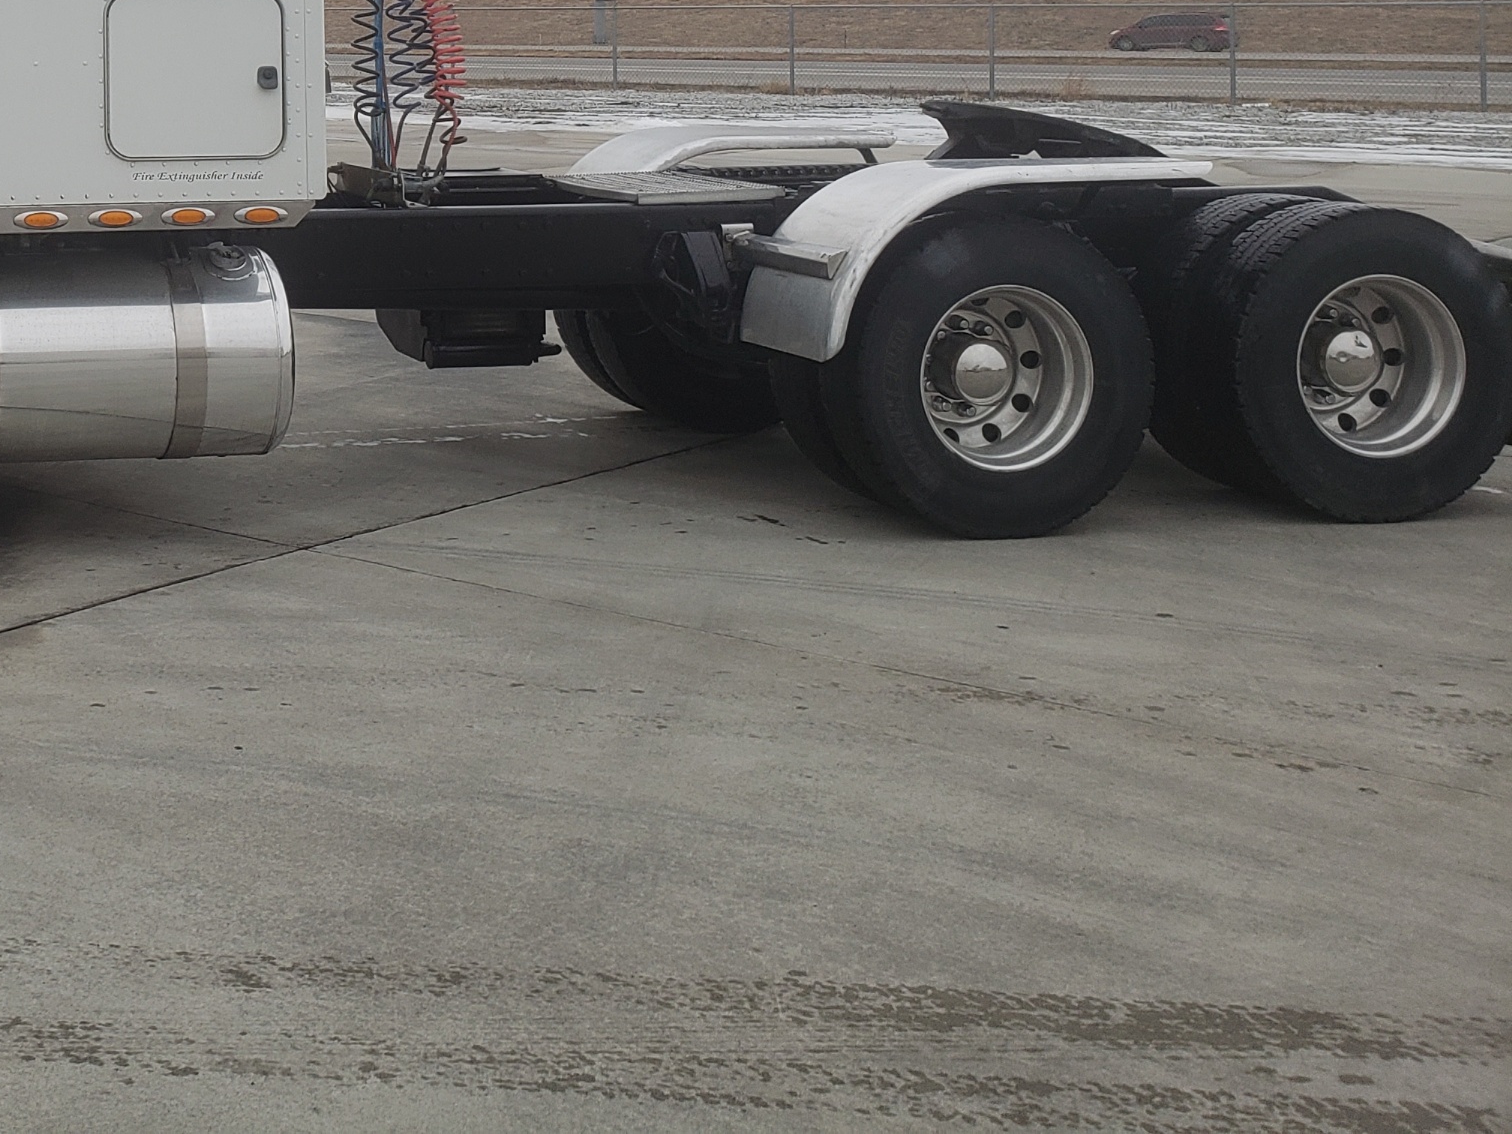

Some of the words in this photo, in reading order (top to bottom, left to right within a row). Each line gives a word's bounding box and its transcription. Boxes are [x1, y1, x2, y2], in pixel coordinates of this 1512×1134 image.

[132, 172, 155, 181] Fire
[157, 171, 228, 183] Extinguisher
[231, 171, 264, 181] Inside
